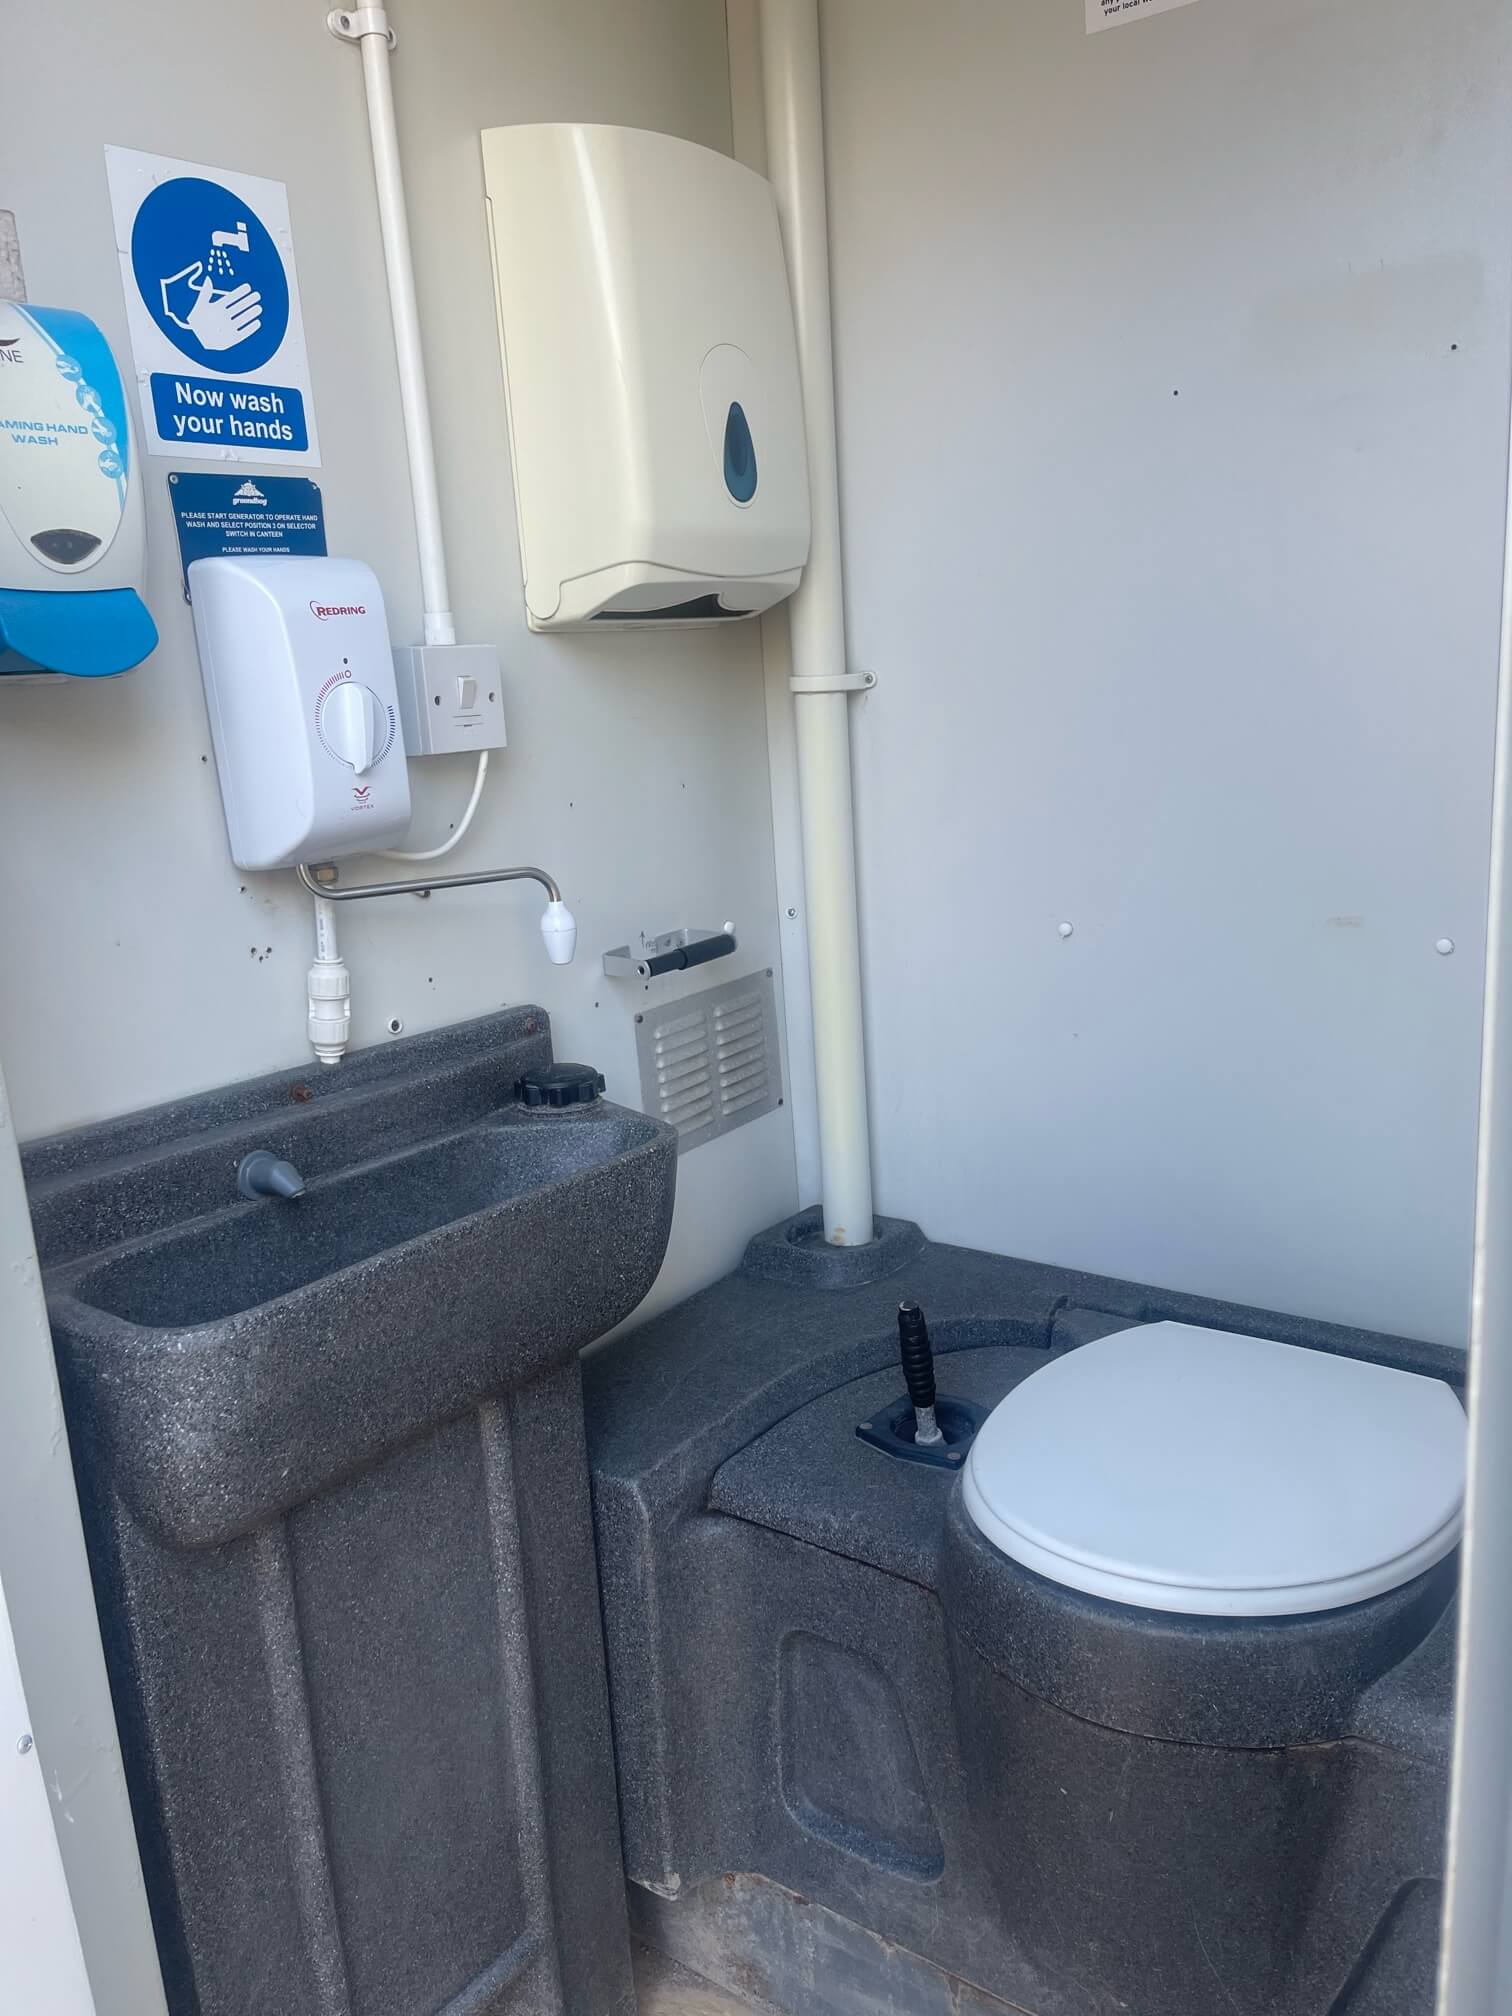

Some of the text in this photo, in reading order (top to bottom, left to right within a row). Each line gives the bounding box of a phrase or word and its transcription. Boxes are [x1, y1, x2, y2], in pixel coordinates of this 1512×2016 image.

[1104, 5, 1120, 16] your
[175, 382, 284, 414] Now wash
[46, 423, 88, 434] HAND
[173, 415, 293, 440] your hands
[11, 434, 58, 445] WASH
[316, 606, 366, 616] REDRING
